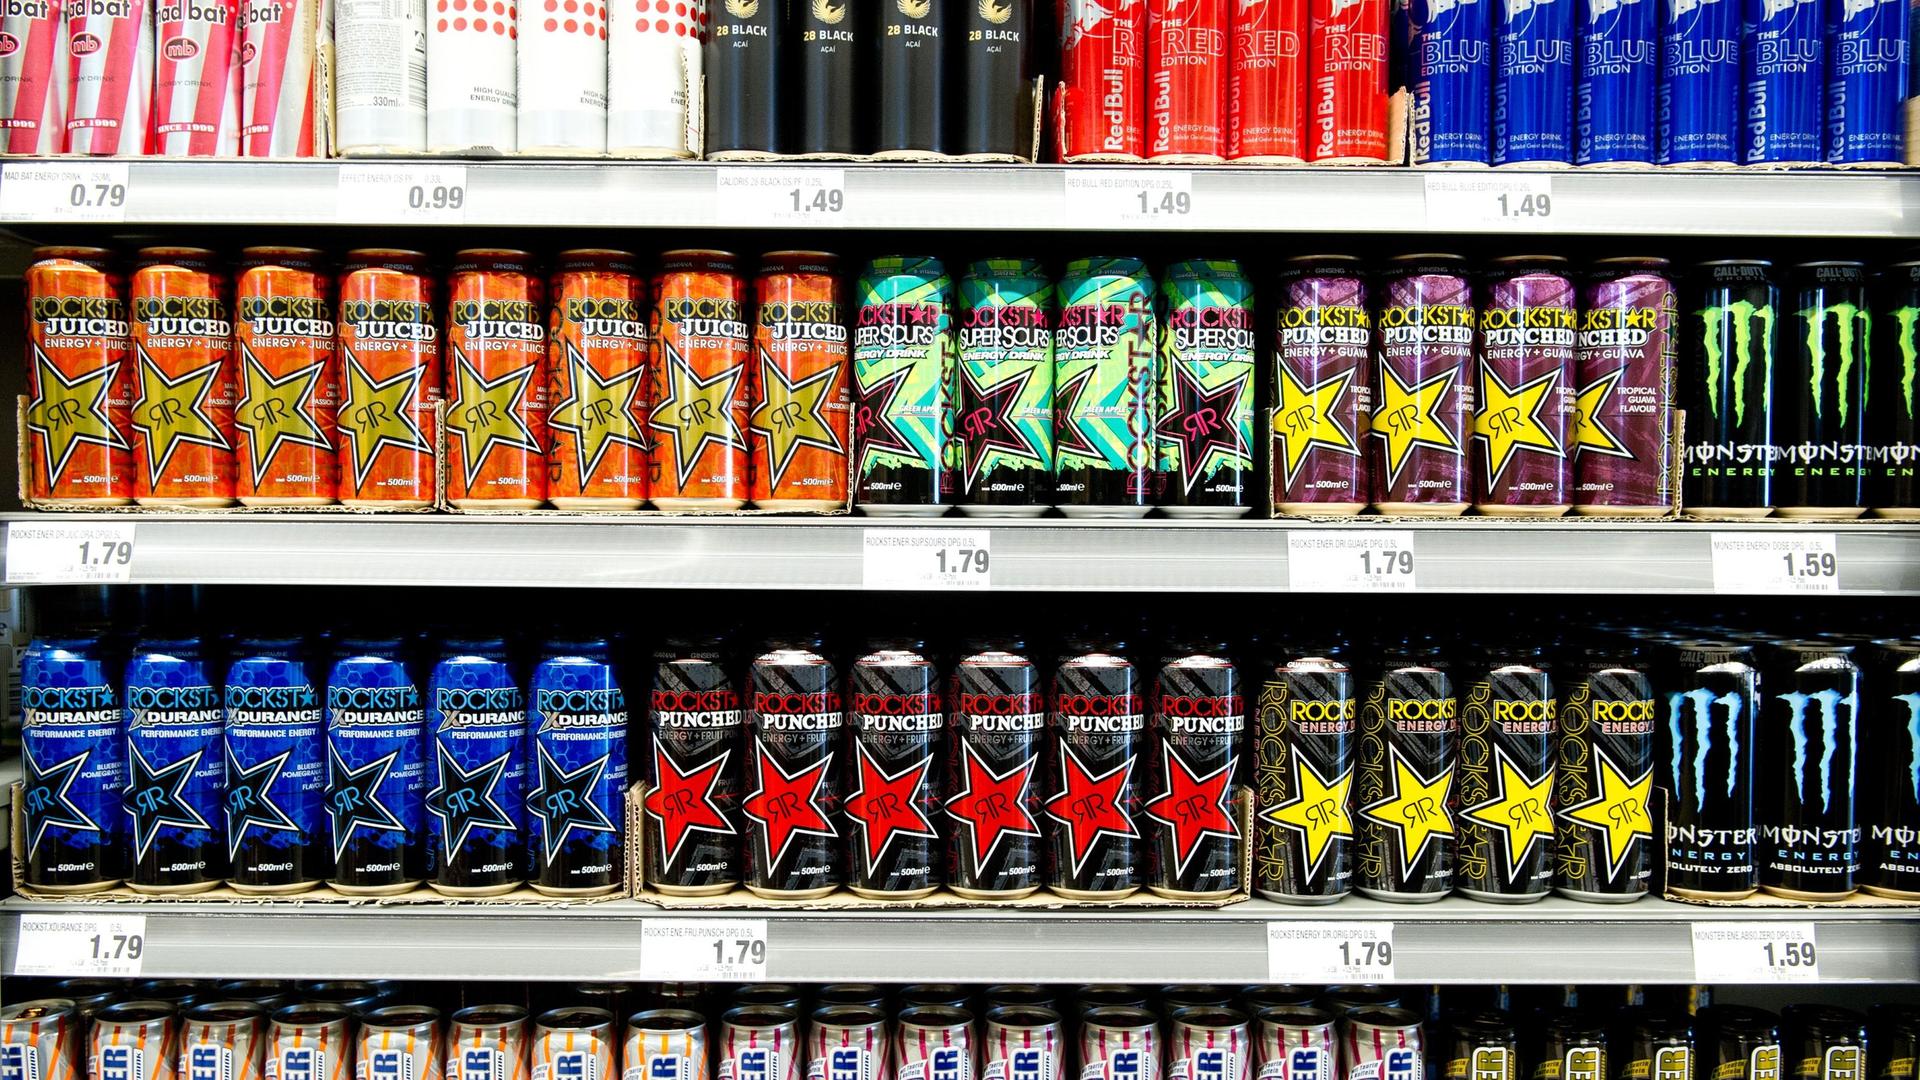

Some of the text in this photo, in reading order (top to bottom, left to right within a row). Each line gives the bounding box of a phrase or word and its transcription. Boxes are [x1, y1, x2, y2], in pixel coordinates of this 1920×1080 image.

[188, 3, 226, 23] bat
[250, 2, 282, 22] bat
[1161, 18, 1182, 29] THE
[1325, 24, 1346, 33] THE
[716, 25, 767, 36] 28 BLACK
[803, 30, 854, 42] 28 BLACK
[887, 25, 938, 37] 28 BLACK
[969, 30, 1020, 42] 28 BLACK
[1422, 32, 1441, 41] THE
[1757, 31, 1779, 40] THE
[1236, 31, 1299, 60] RED
[1502, 39, 1572, 65] BLUE
[1664, 40, 1738, 65] BLUE
[1161, 55, 1207, 67] EDITION
[1325, 61, 1370, 72] EDITION
[1422, 64, 1468, 77] EDITION
[1756, 63, 1806, 75] EDITION
[473, 86, 492, 94] HIGH
[470, 94, 500, 103] ENERGY
[1154, 71, 1170, 152] Red Bull
[1317, 76, 1334, 156] Red Bull
[1415, 81, 1430, 163] Red Bull
[1749, 80, 1766, 162] Red Bull
[1173, 124, 1201, 133] ENERGY
[1243, 127, 1270, 135] ENERGY
[1434, 133, 1463, 141] ENERGY
[1510, 133, 1561, 142] ENERGY DRINK
[1595, 134, 1646, 142] ENERGY DRINK
[70, 184, 125, 206] 0.79
[409, 186, 464, 209] 0.99
[790, 189, 843, 212] 1.49
[1137, 191, 1191, 214] 1.49
[1498, 194, 1551, 216] 1.49
[148, 318, 230, 337] JUICED
[254, 317, 334, 337] JUICED
[356, 321, 436, 341] JUICED
[466, 321, 544, 341] JUICED
[772, 323, 847, 342] JUICED
[1282, 327, 1369, 344] PUNCHED
[1385, 327, 1472, 344] PUNCHED
[45, 338, 91, 348] ENERGY
[147, 339, 192, 348] ENERGY
[252, 338, 296, 348] ENERGY
[355, 341, 436, 354] ENERGY JUICE
[1009, 352, 1046, 361] DRINK
[1285, 348, 1367, 358] ENERGY GUAVA
[1617, 387, 1656, 395] TROPICAL
[1620, 405, 1656, 413] FLAVOUR
[1693, 468, 1775, 476] ENERGY
[79, 541, 132, 565] 1.79
[936, 549, 989, 573] 1.79
[1360, 550, 1413, 574] 1.79
[1783, 553, 1836, 576] 1.59
[23, 709, 121, 726] XDURANCE
[226, 709, 322, 725] XDURANCE
[330, 708, 424, 726] XDURANCE
[659, 711, 741, 728] PUNCHED
[762, 713, 842, 730] PUNCHED
[863, 714, 943, 730] PUNCHED
[30, 729, 116, 738] PERFORMANCE ENERGY
[233, 729, 316, 738] PERFORMANCE ENERGY
[1301, 722, 1348, 732] ENERGY
[1504, 722, 1550, 732] ENERGY
[339, 730, 394, 738] PERFORMANCE
[659, 731, 723, 741] ENERGY FRUIT
[1673, 849, 1746, 860] NERGY
[1726, 864, 1752, 873] ZERO
[1770, 863, 1842, 873] ABSOLUTELY
[90, 935, 142, 959] 1.79
[713, 940, 765, 964] 1.79
[1340, 941, 1391, 965] 1.79
[1764, 942, 1815, 966] 1.59
